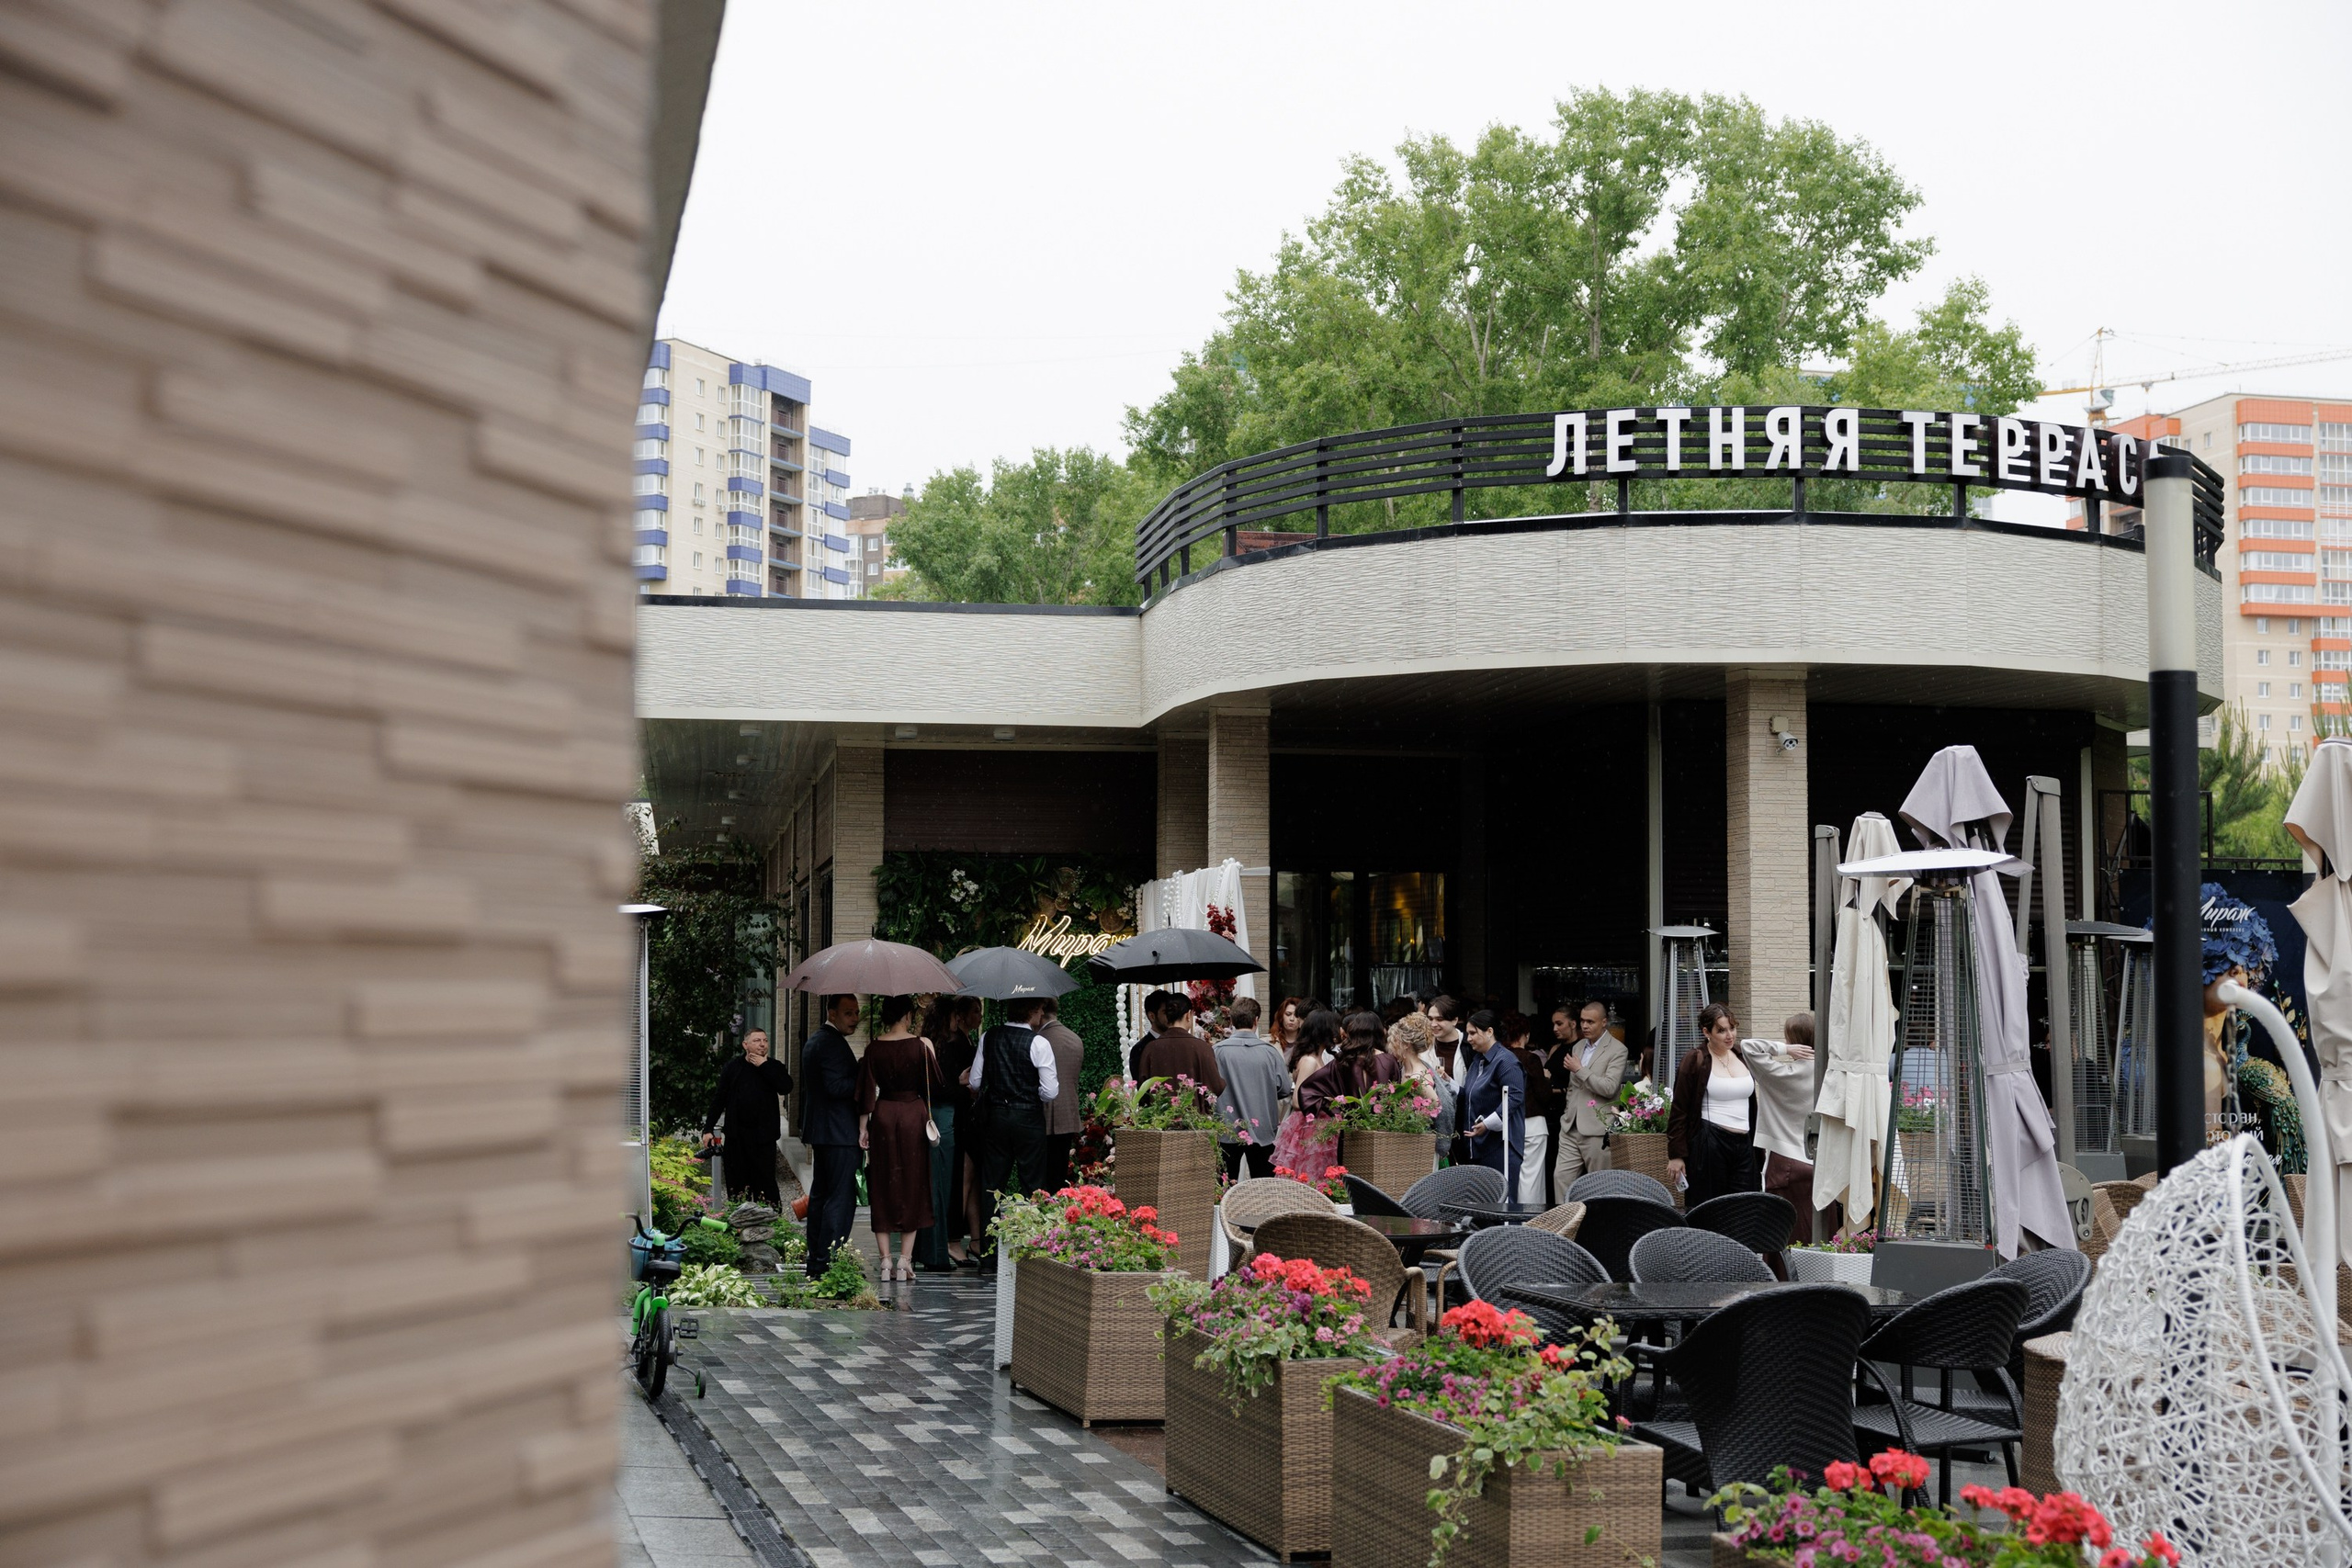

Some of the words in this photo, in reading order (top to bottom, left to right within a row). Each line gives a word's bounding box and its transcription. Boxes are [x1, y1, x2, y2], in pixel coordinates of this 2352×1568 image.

[1547, 407, 1859, 477] ЛЕТНЯЯ
[1903, 411, 2160, 495] ТЕРРАС
[2205, 1112, 2261, 1125] сторан,
